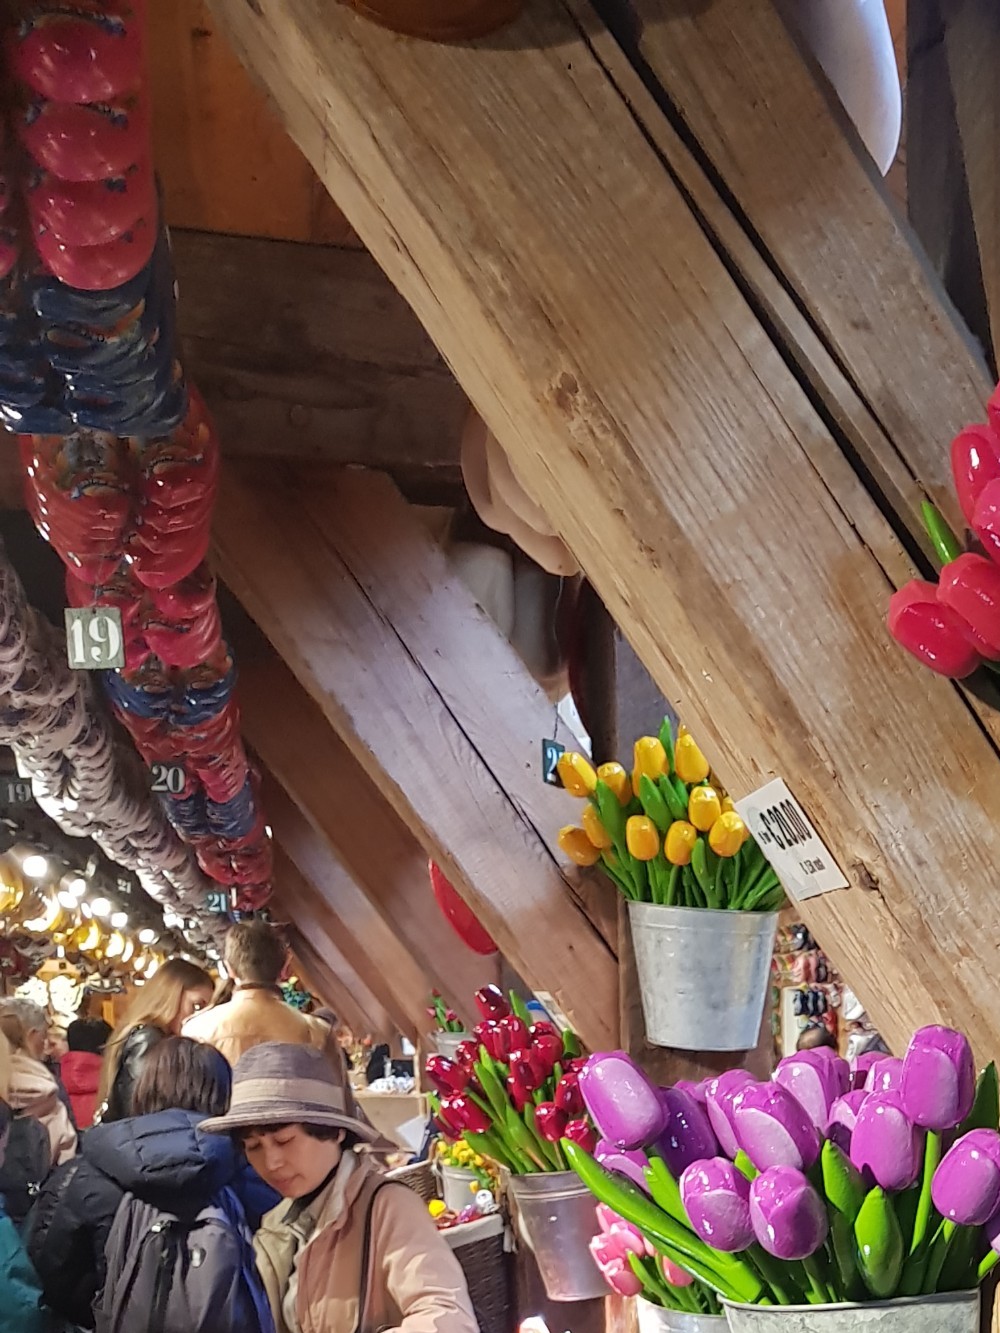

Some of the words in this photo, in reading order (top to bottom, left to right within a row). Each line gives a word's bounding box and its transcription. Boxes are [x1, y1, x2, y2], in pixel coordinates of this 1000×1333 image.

[71, 616, 120, 663] 19
[151, 765, 186, 793] 20
[8, 783, 31, 803] 19
[207, 893, 227, 912] 21
